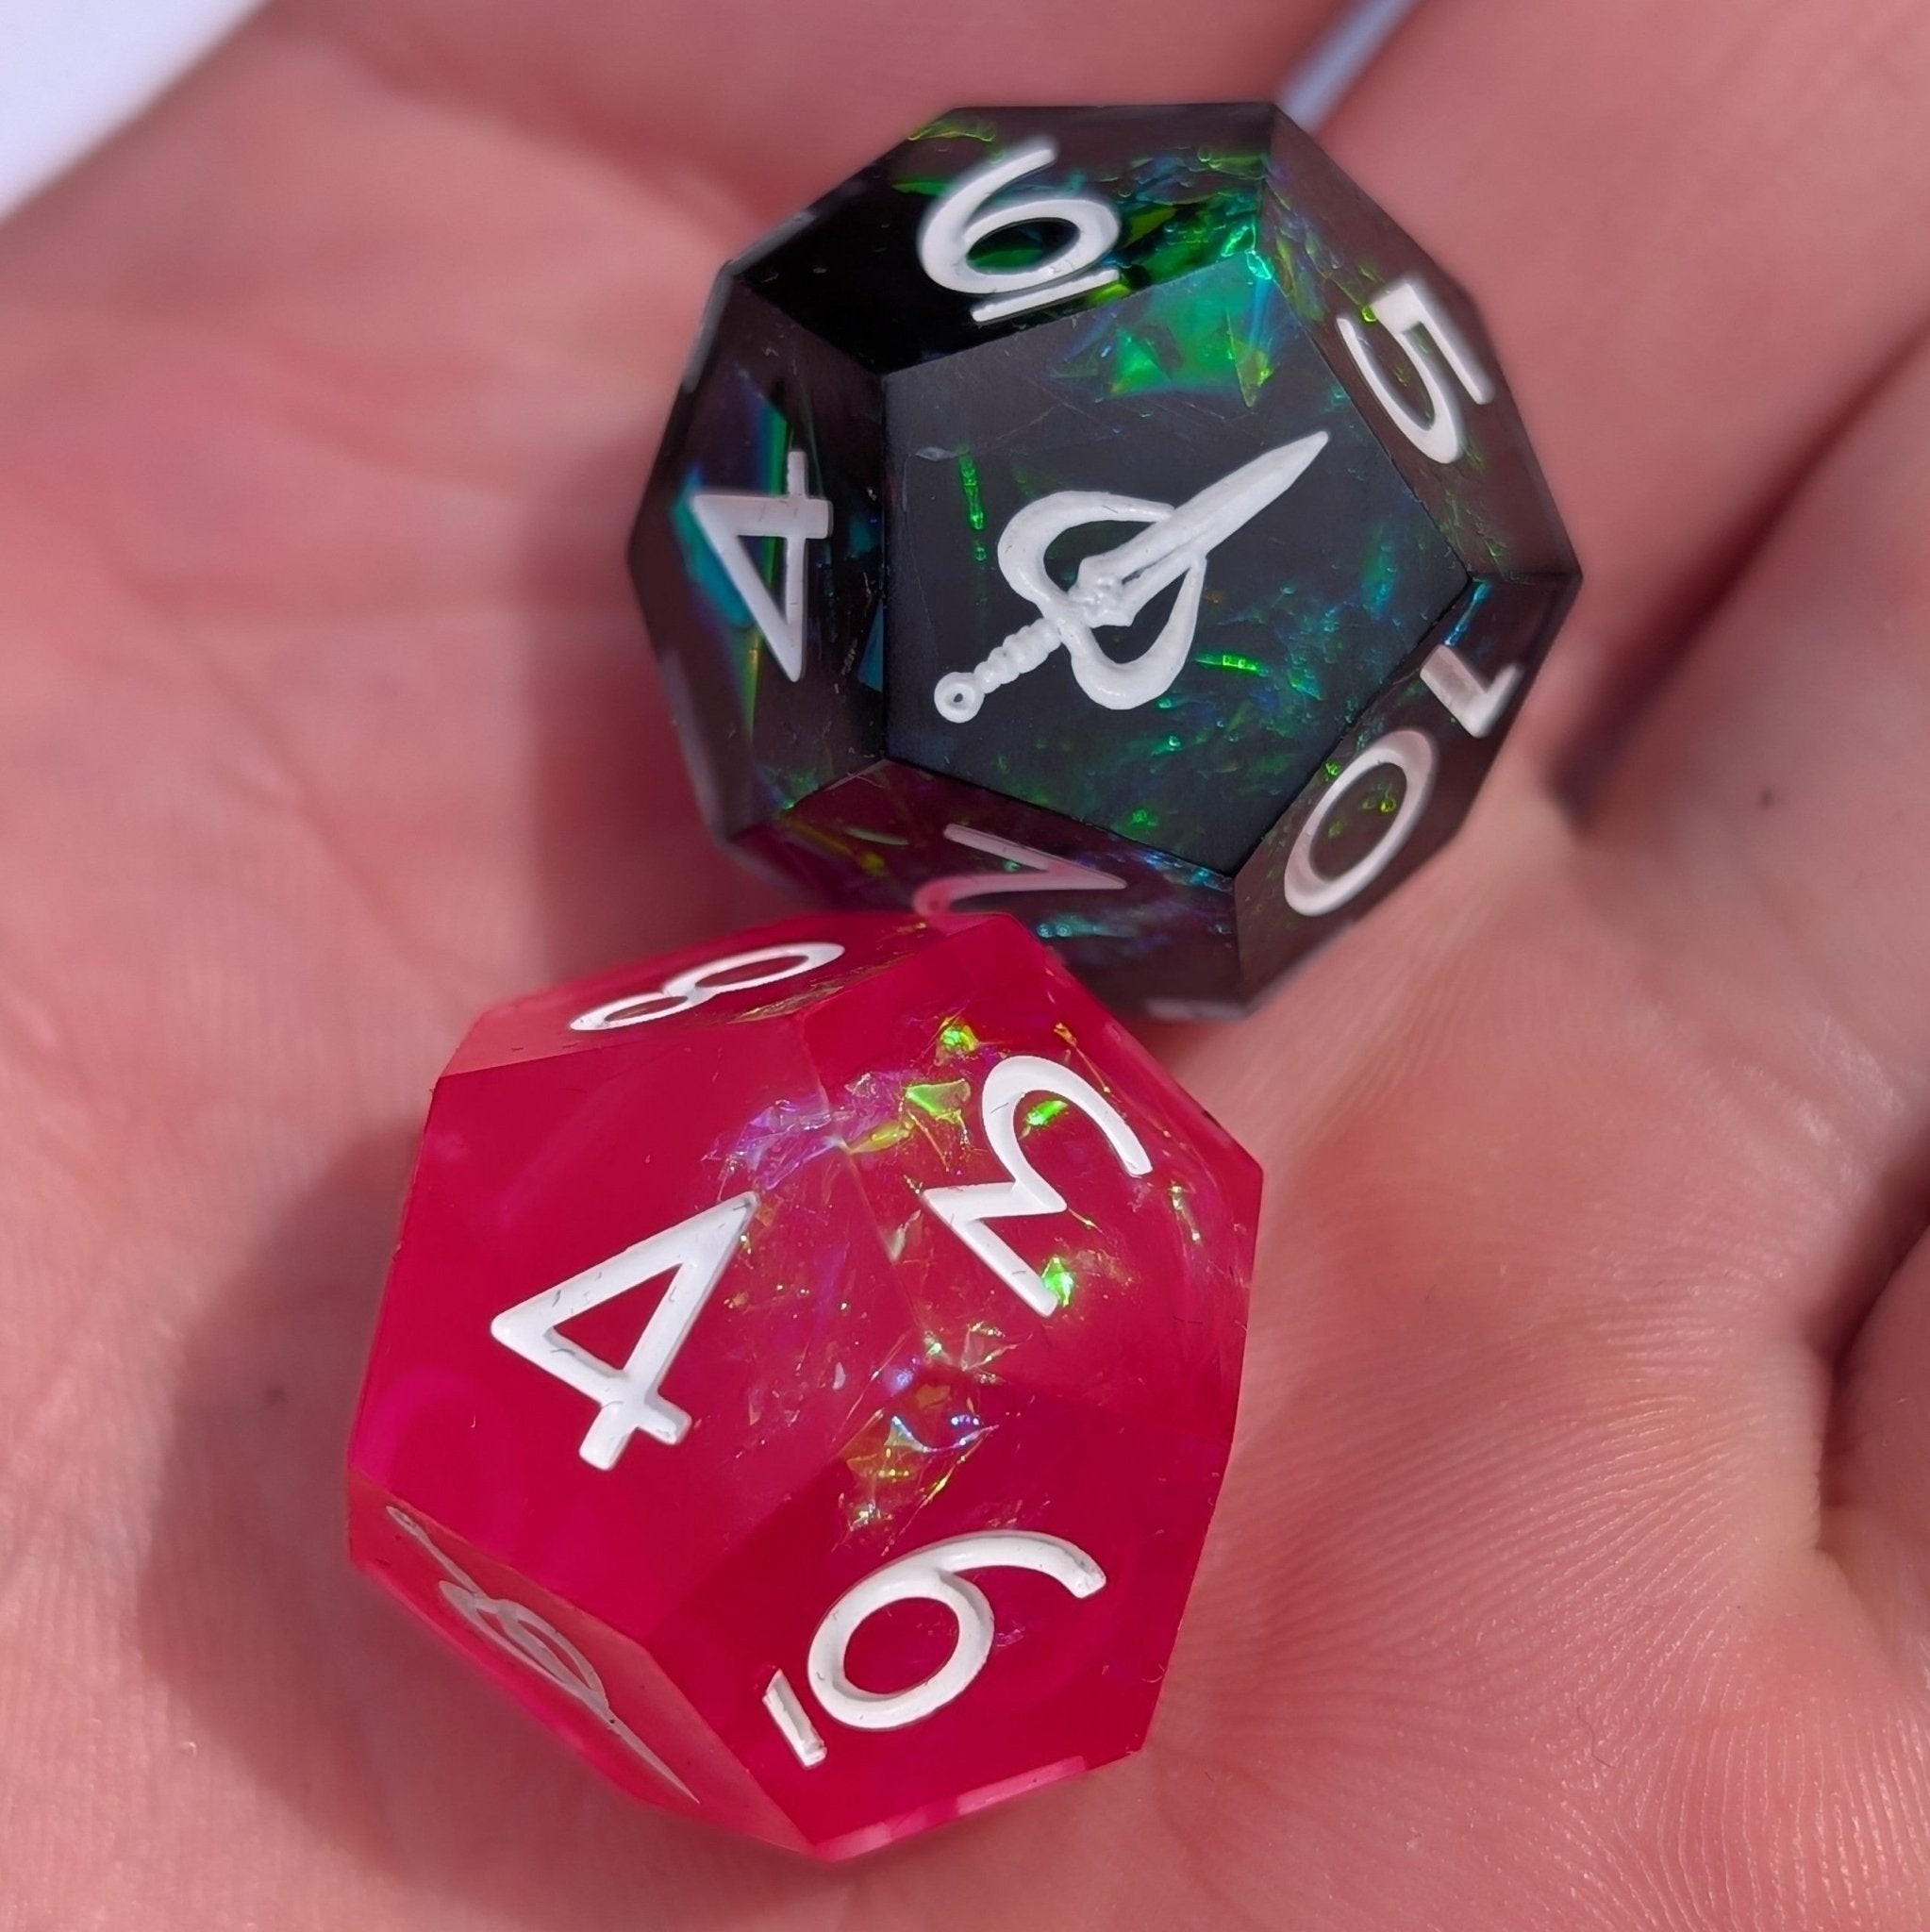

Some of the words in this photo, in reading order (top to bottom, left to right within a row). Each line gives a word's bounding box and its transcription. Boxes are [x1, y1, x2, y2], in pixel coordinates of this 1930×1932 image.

[919, 139, 1121, 322] 6
[1337, 280, 1494, 464] 5
[691, 450, 832, 683] 4
[1283, 645, 1524, 916] 10
[569, 941, 846, 1031] 8
[923, 1055, 1153, 1317] 3
[491, 1191, 757, 1472] 4
[762, 1529, 1107, 1769] 6
